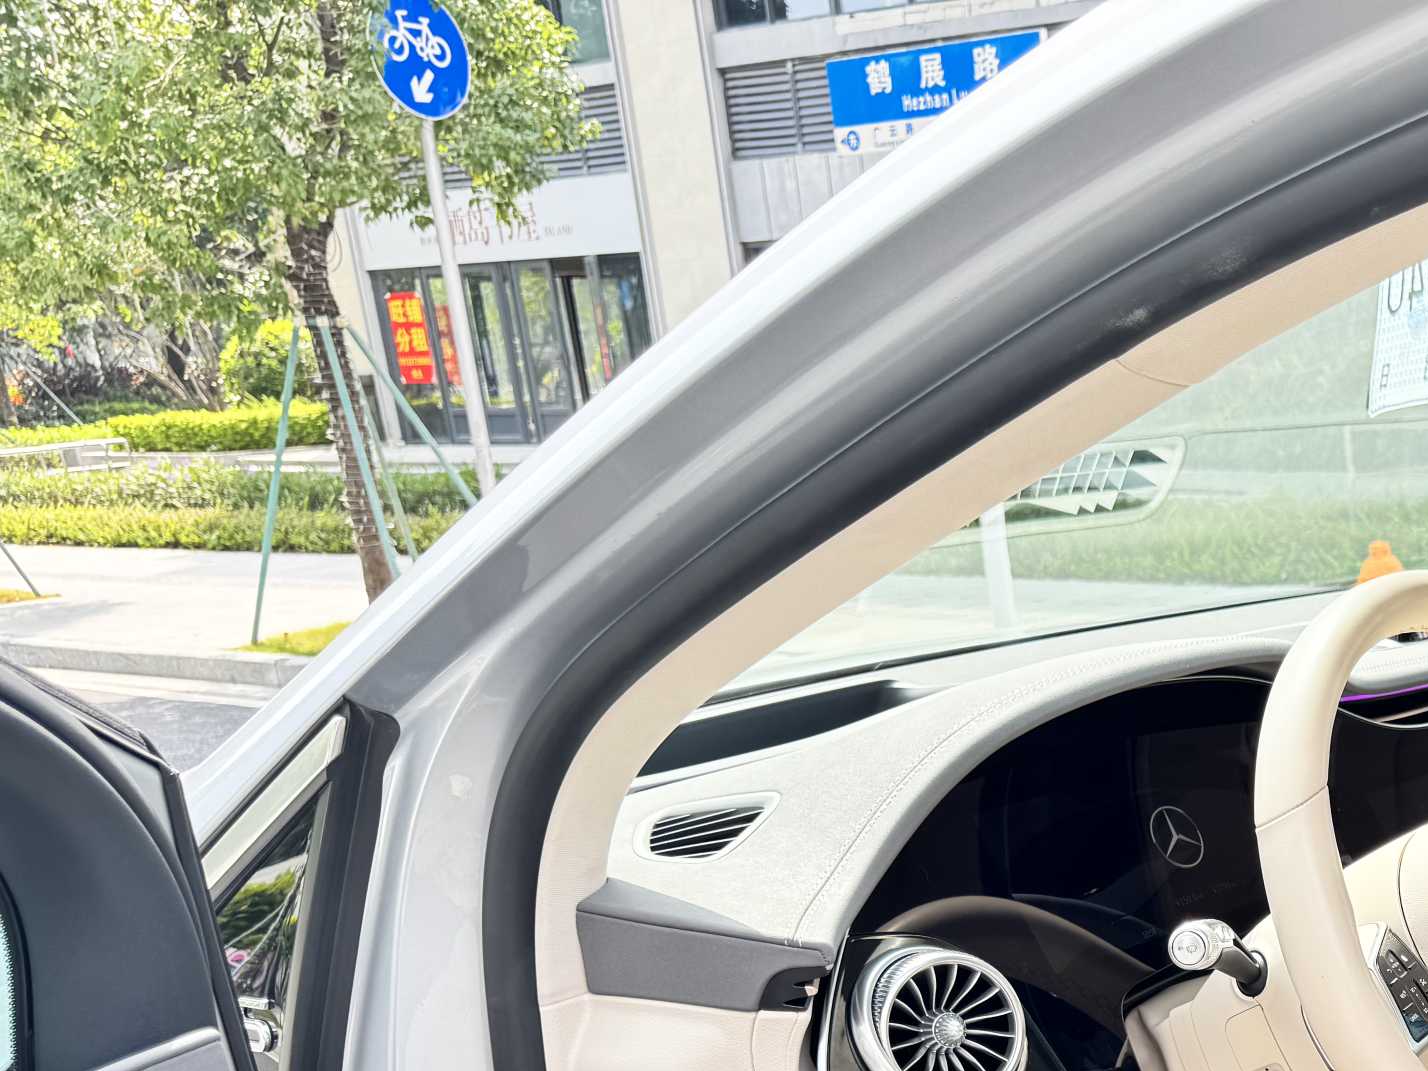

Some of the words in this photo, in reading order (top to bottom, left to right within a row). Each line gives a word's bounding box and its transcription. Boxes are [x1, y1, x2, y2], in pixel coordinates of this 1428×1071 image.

[865, 44, 1000, 96] 鹤展路
[901, 90, 950, 113] Hezhan
